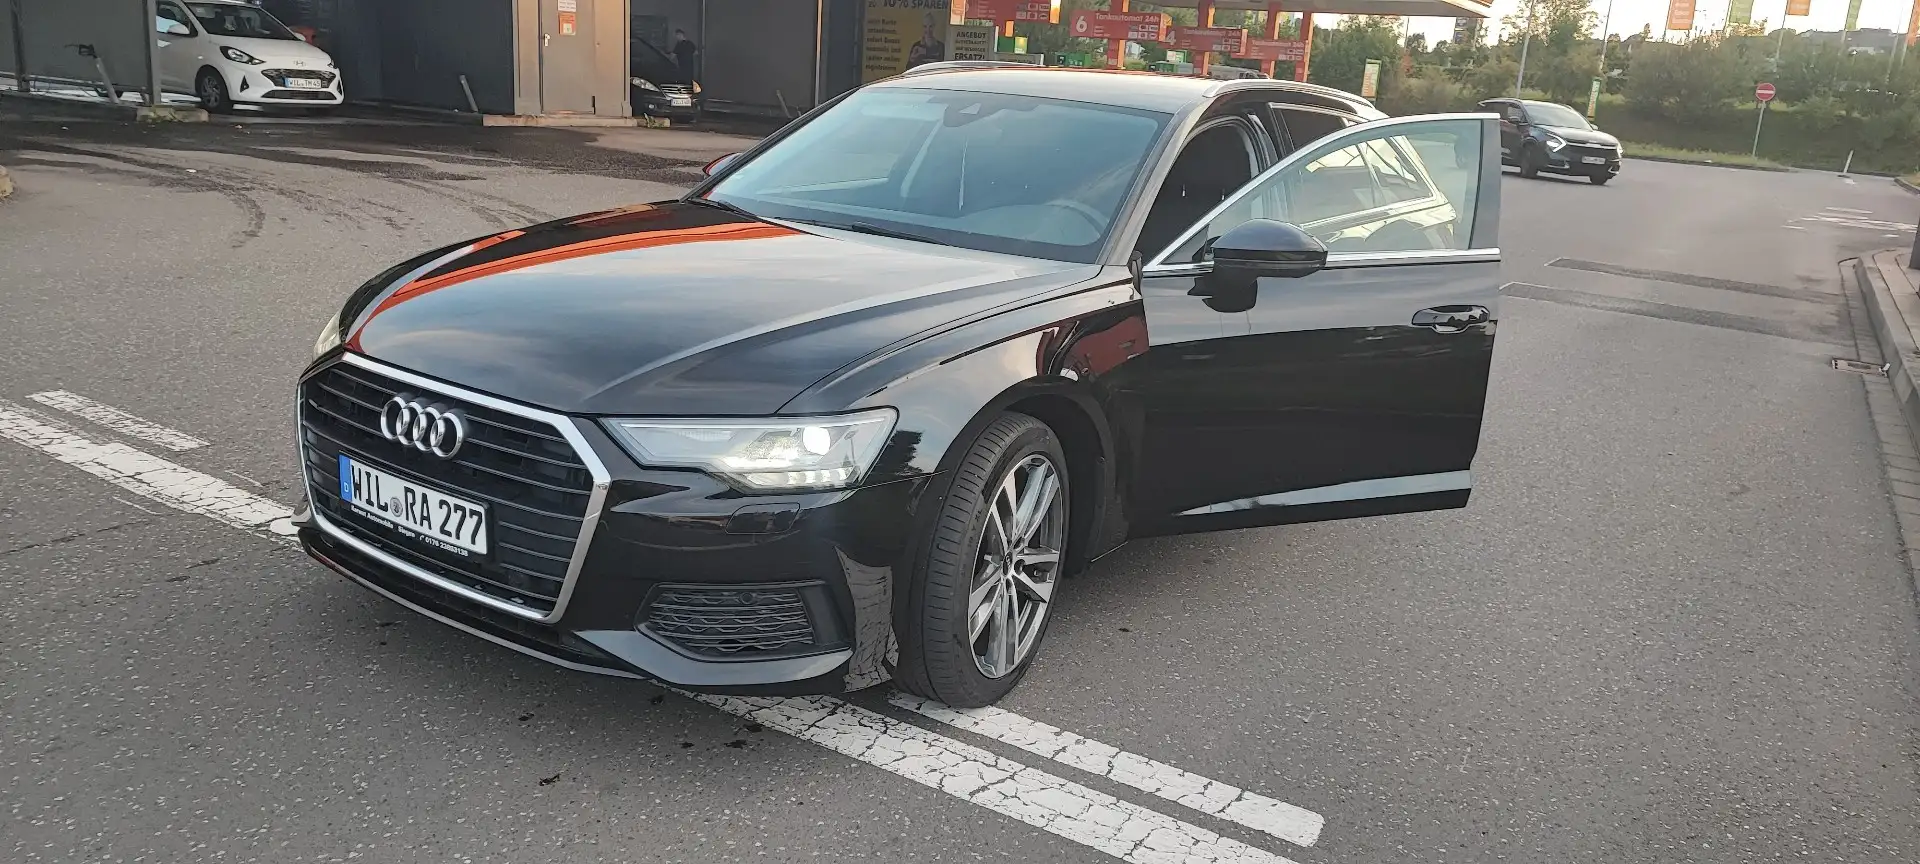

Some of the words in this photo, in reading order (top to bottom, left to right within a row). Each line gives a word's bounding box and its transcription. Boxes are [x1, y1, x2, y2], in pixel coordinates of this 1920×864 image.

[911, 0, 948, 10] SPAREN
[1076, 15, 1088, 33] 6
[1095, 12, 1143, 22] Tankautomat
[1144, 15, 1160, 23] 24h
[956, 31, 987, 39] ANGEBOT
[1166, 30, 1177, 46] 4
[351, 464, 389, 513] WIL
[403, 485, 433, 531] RA
[438, 498, 484, 546] 277
